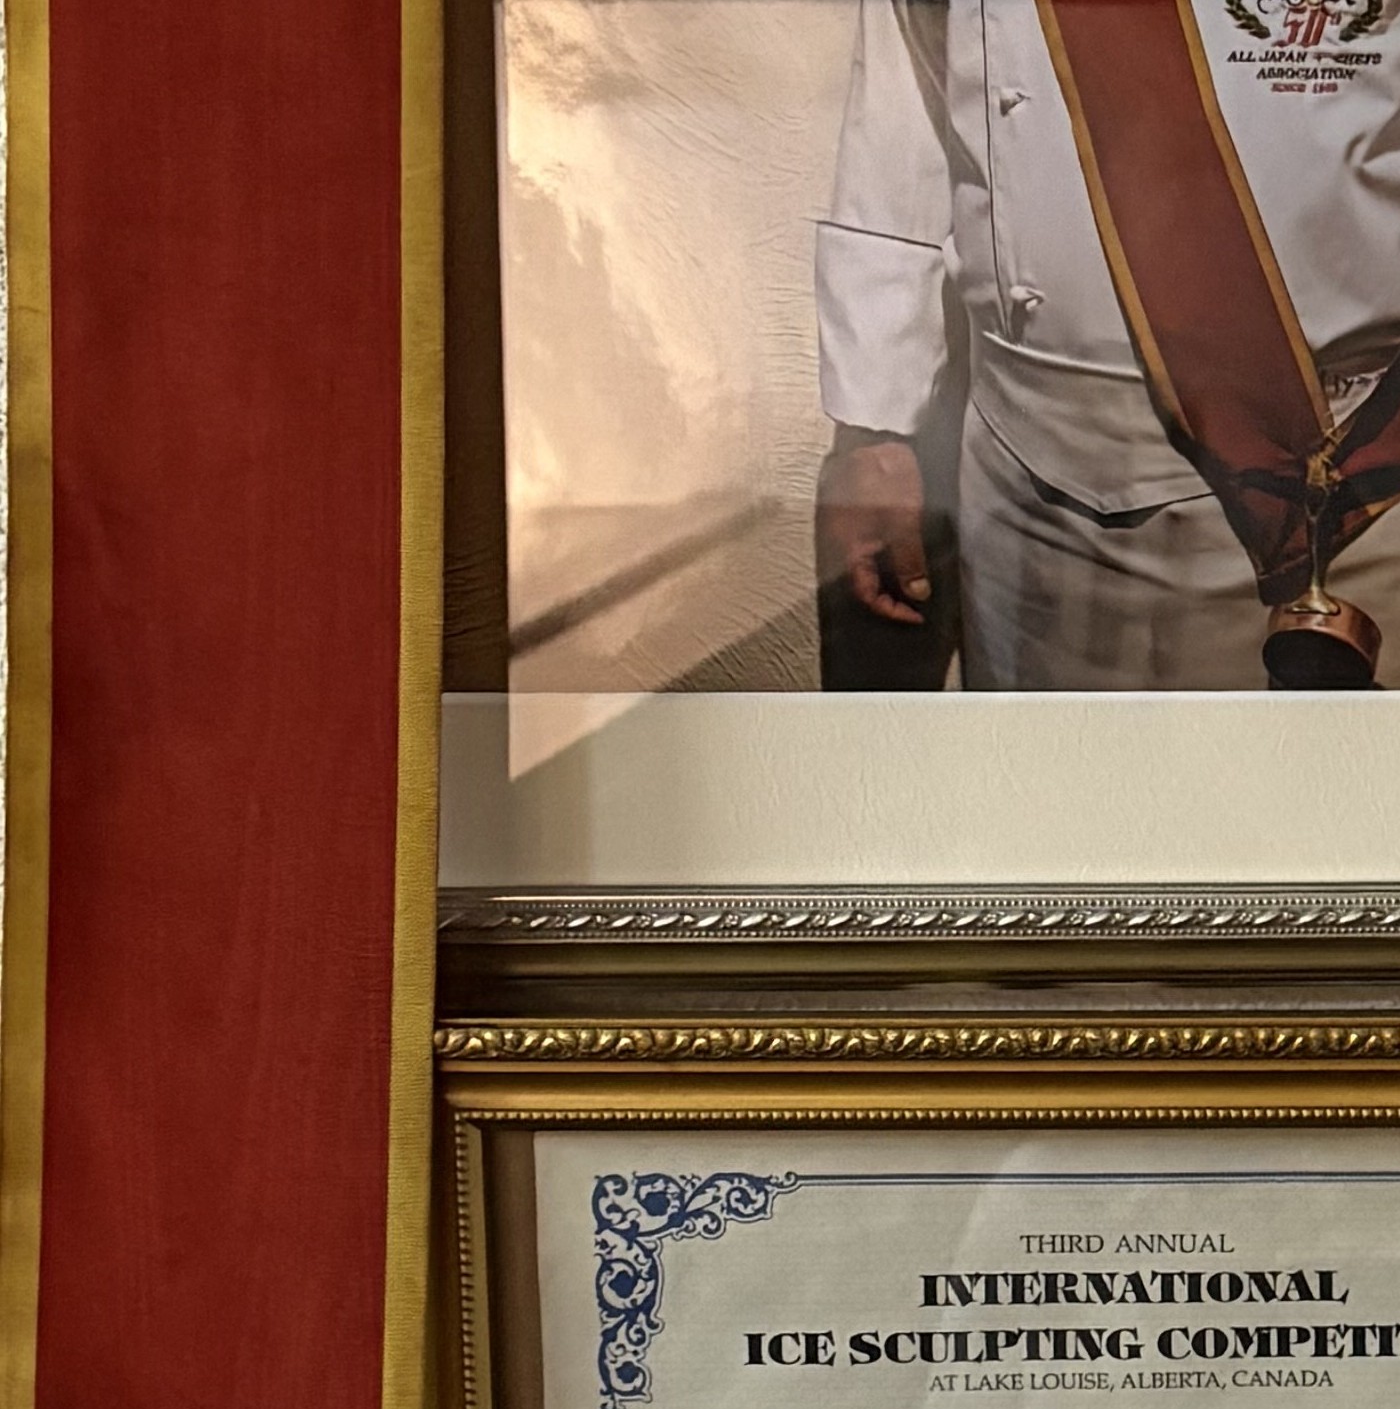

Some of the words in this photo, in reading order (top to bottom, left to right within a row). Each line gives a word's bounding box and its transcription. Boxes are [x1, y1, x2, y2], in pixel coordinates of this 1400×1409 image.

[1227, 51, 1256, 63] ALL
[1259, 51, 1308, 64] JAPAN
[1019, 1234, 1105, 1256] THIRD
[1114, 1233, 1236, 1255] ANNUAL
[918, 1269, 1350, 1309] INTERNATIONAL
[743, 1330, 838, 1367] ICE
[848, 1326, 1144, 1368] SCULPTING
[929, 1372, 957, 1393] AT
[963, 1372, 1025, 1393] LAKE
[1028, 1372, 1115, 1394] LOUISE,
[1120, 1370, 1229, 1393] ALBERTA,
[1231, 1369, 1335, 1390] CANADA
